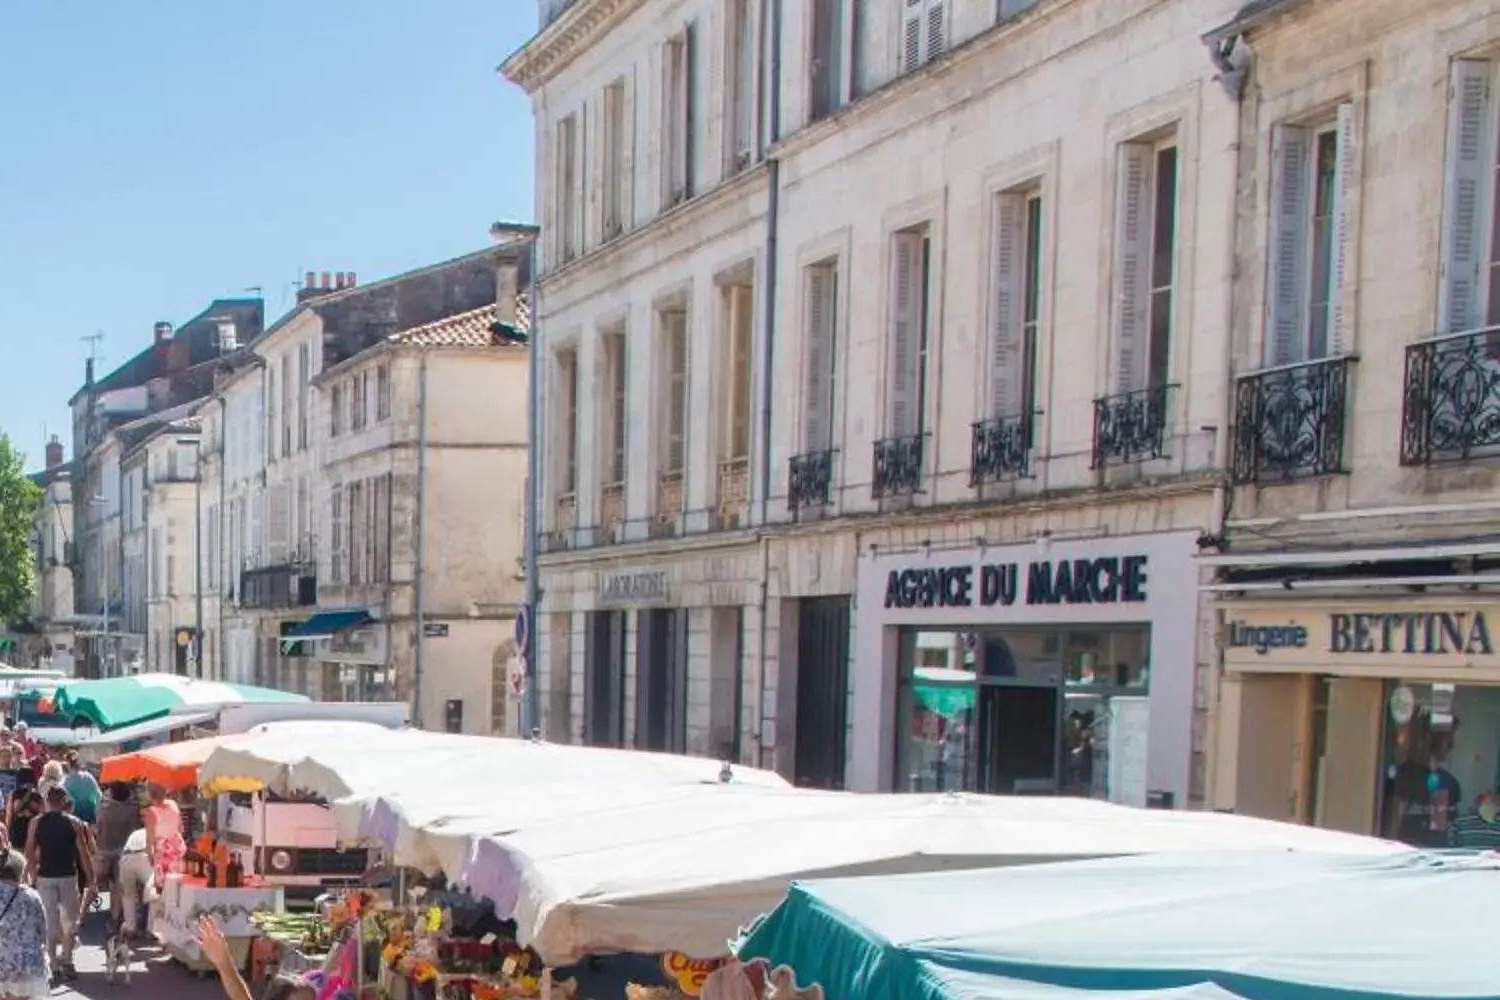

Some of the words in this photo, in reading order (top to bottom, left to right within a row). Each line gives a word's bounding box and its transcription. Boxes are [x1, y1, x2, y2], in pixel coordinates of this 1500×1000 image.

[884, 566, 972, 608] AGENCE
[980, 562, 1018, 606] DU
[1026, 555, 1148, 605] MARCHE
[1229, 619, 1308, 655] Lingerie
[1329, 611, 1494, 654] BETTINA
